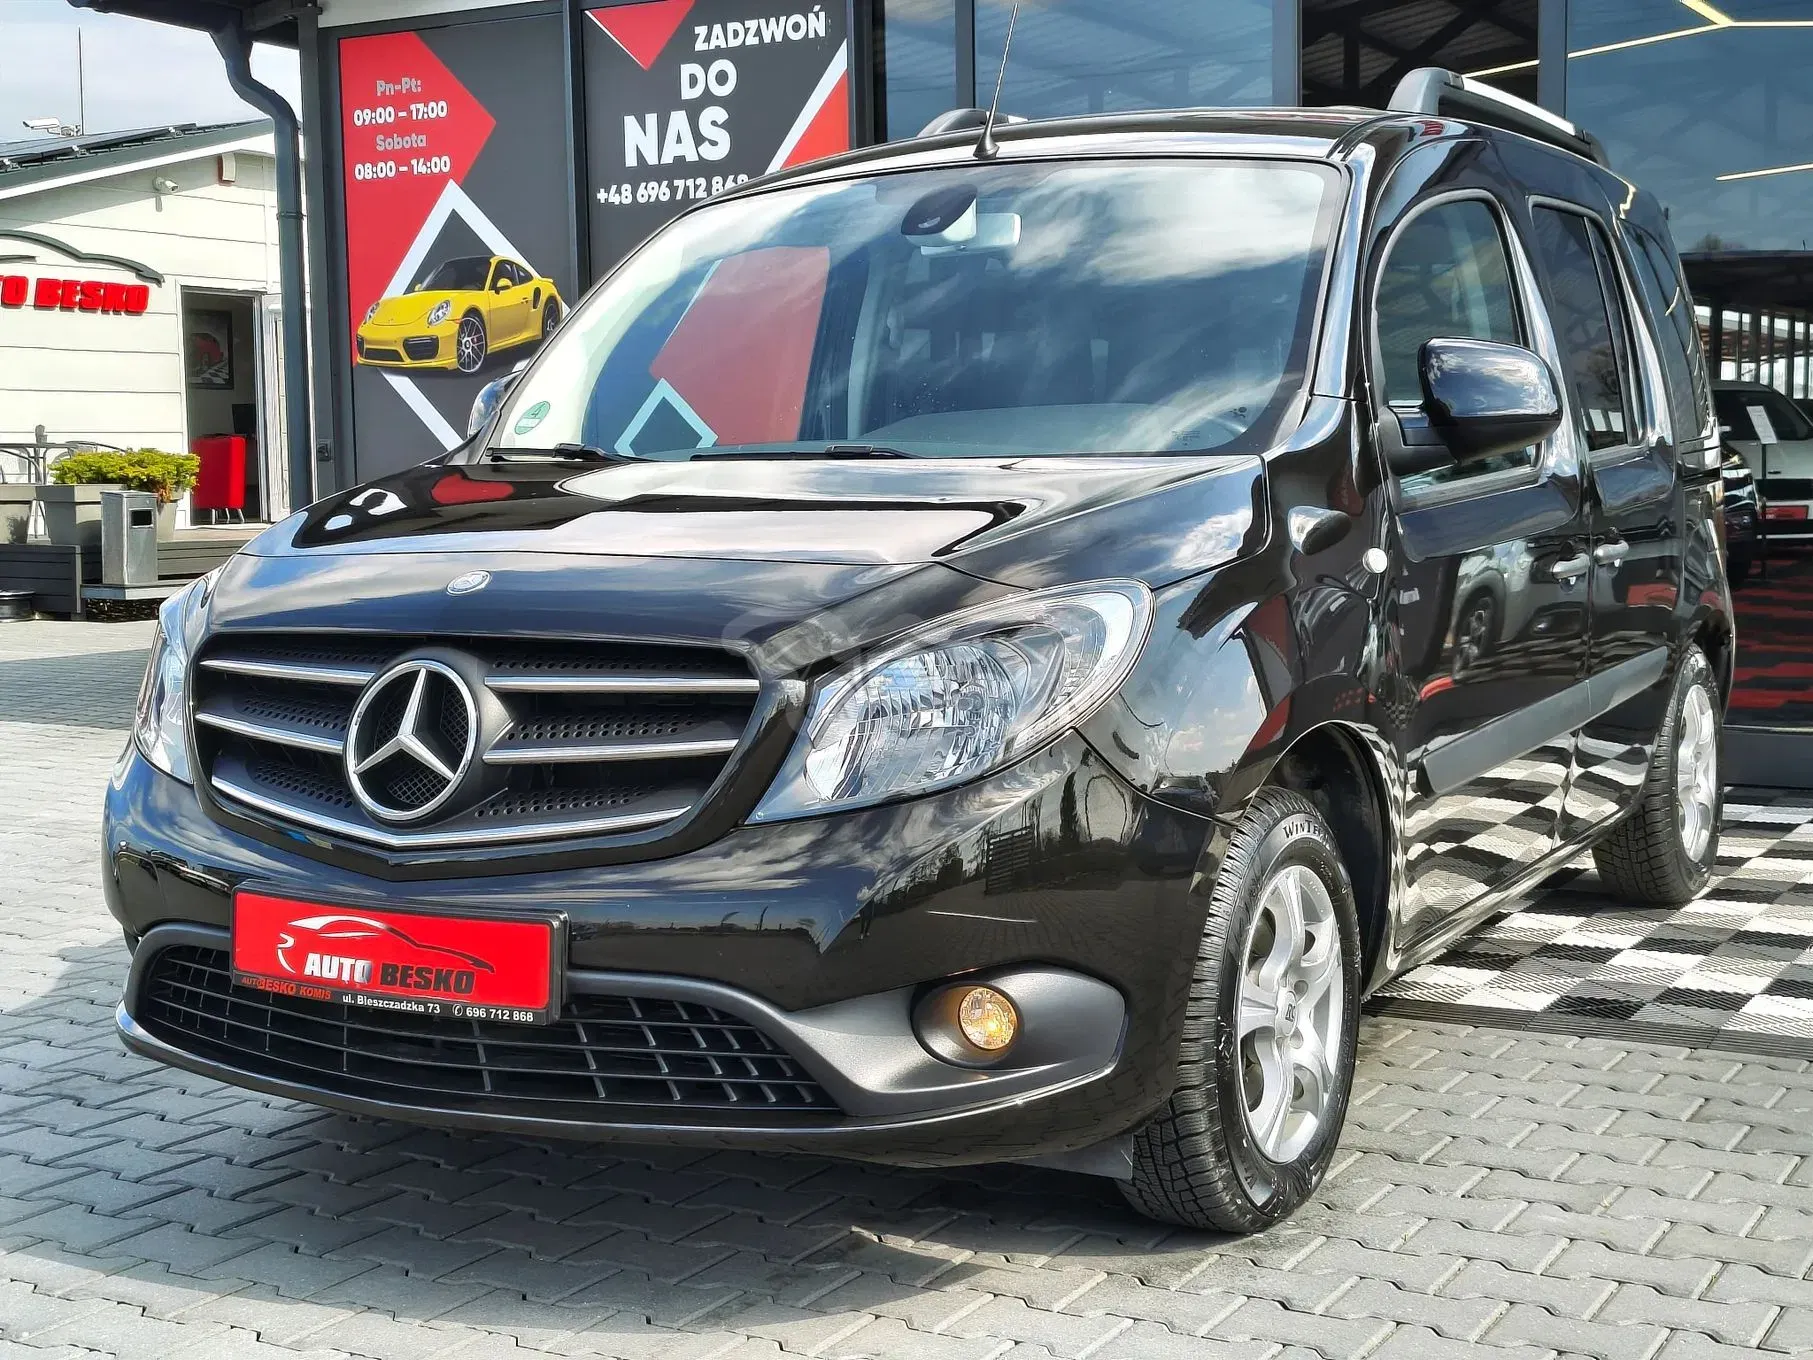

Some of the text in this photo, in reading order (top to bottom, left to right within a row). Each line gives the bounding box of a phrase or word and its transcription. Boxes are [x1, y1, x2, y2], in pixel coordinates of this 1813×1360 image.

[694, 5, 826, 52] ZADZWOŃ
[376, 77, 422, 97] Pn-Pt:
[680, 59, 737, 100] DO
[353, 106, 395, 127] 09:00
[409, 100, 448, 121] 17:00
[375, 132, 427, 151] Sobota
[623, 106, 731, 168] NAS
[354, 160, 397, 181] 08:00
[410, 155, 451, 176] 14:00
[596, 183, 633, 205] +48
[636, 180, 671, 203] 696
[673, 177, 708, 200] 712
[34, 277, 149, 315] BESKO
[303, 952, 475, 995] AUTO BESKO
[299, 985, 332, 1000] KOMIS
[342, 994, 355, 1004] ul.
[427, 1003, 441, 1014] 73
[466, 1007, 487, 1018] 696
[489, 1009, 510, 1020] 712
[512, 1010, 534, 1022] 868
